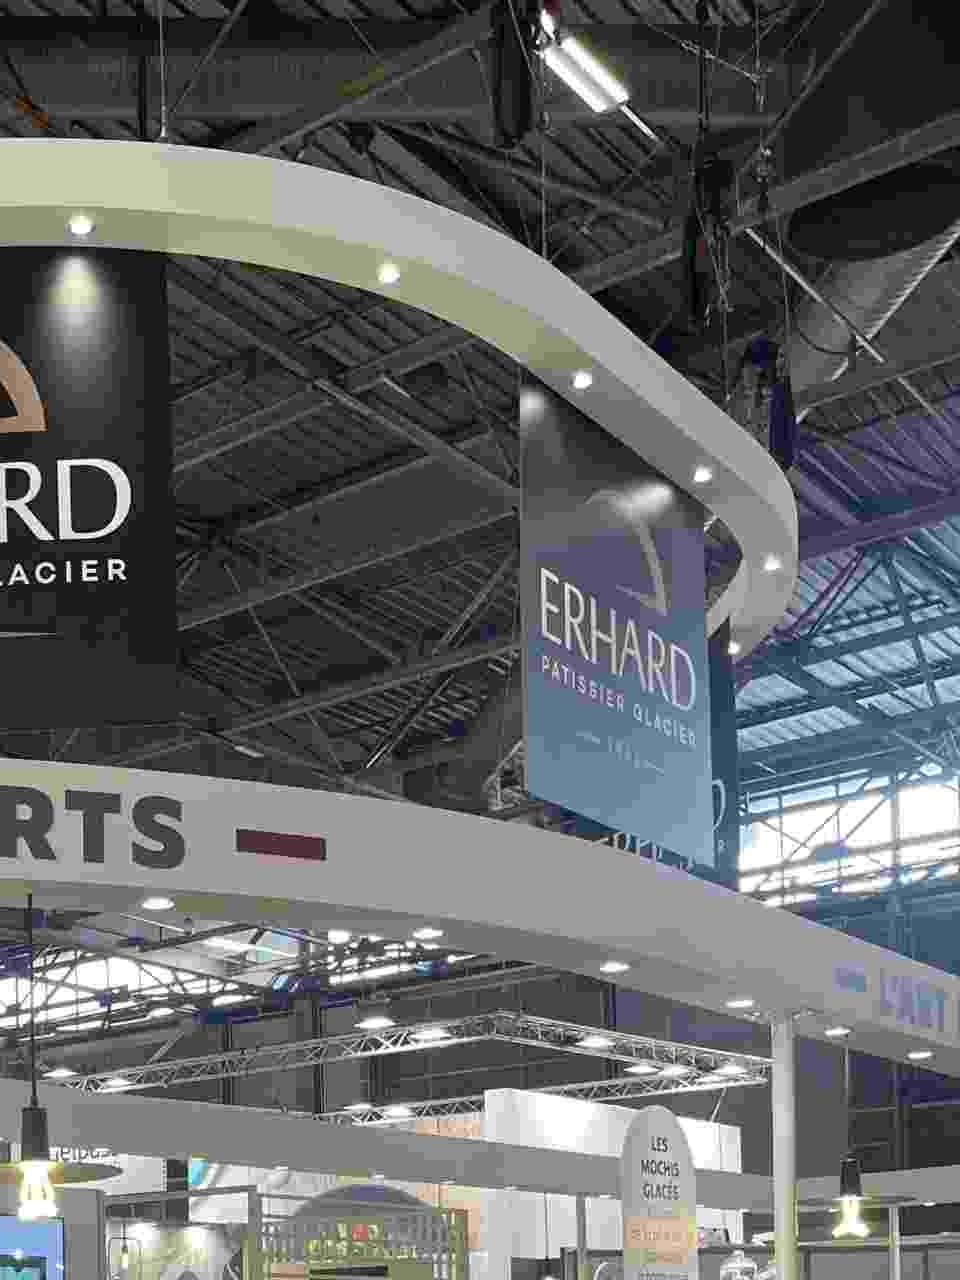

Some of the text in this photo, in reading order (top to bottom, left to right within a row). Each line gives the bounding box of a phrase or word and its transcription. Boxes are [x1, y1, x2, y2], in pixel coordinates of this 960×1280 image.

[540, 566, 697, 712] ERHARD
[542, 655, 698, 747] PATISSIER GLACIER
[651, 1136, 669, 1152] LES
